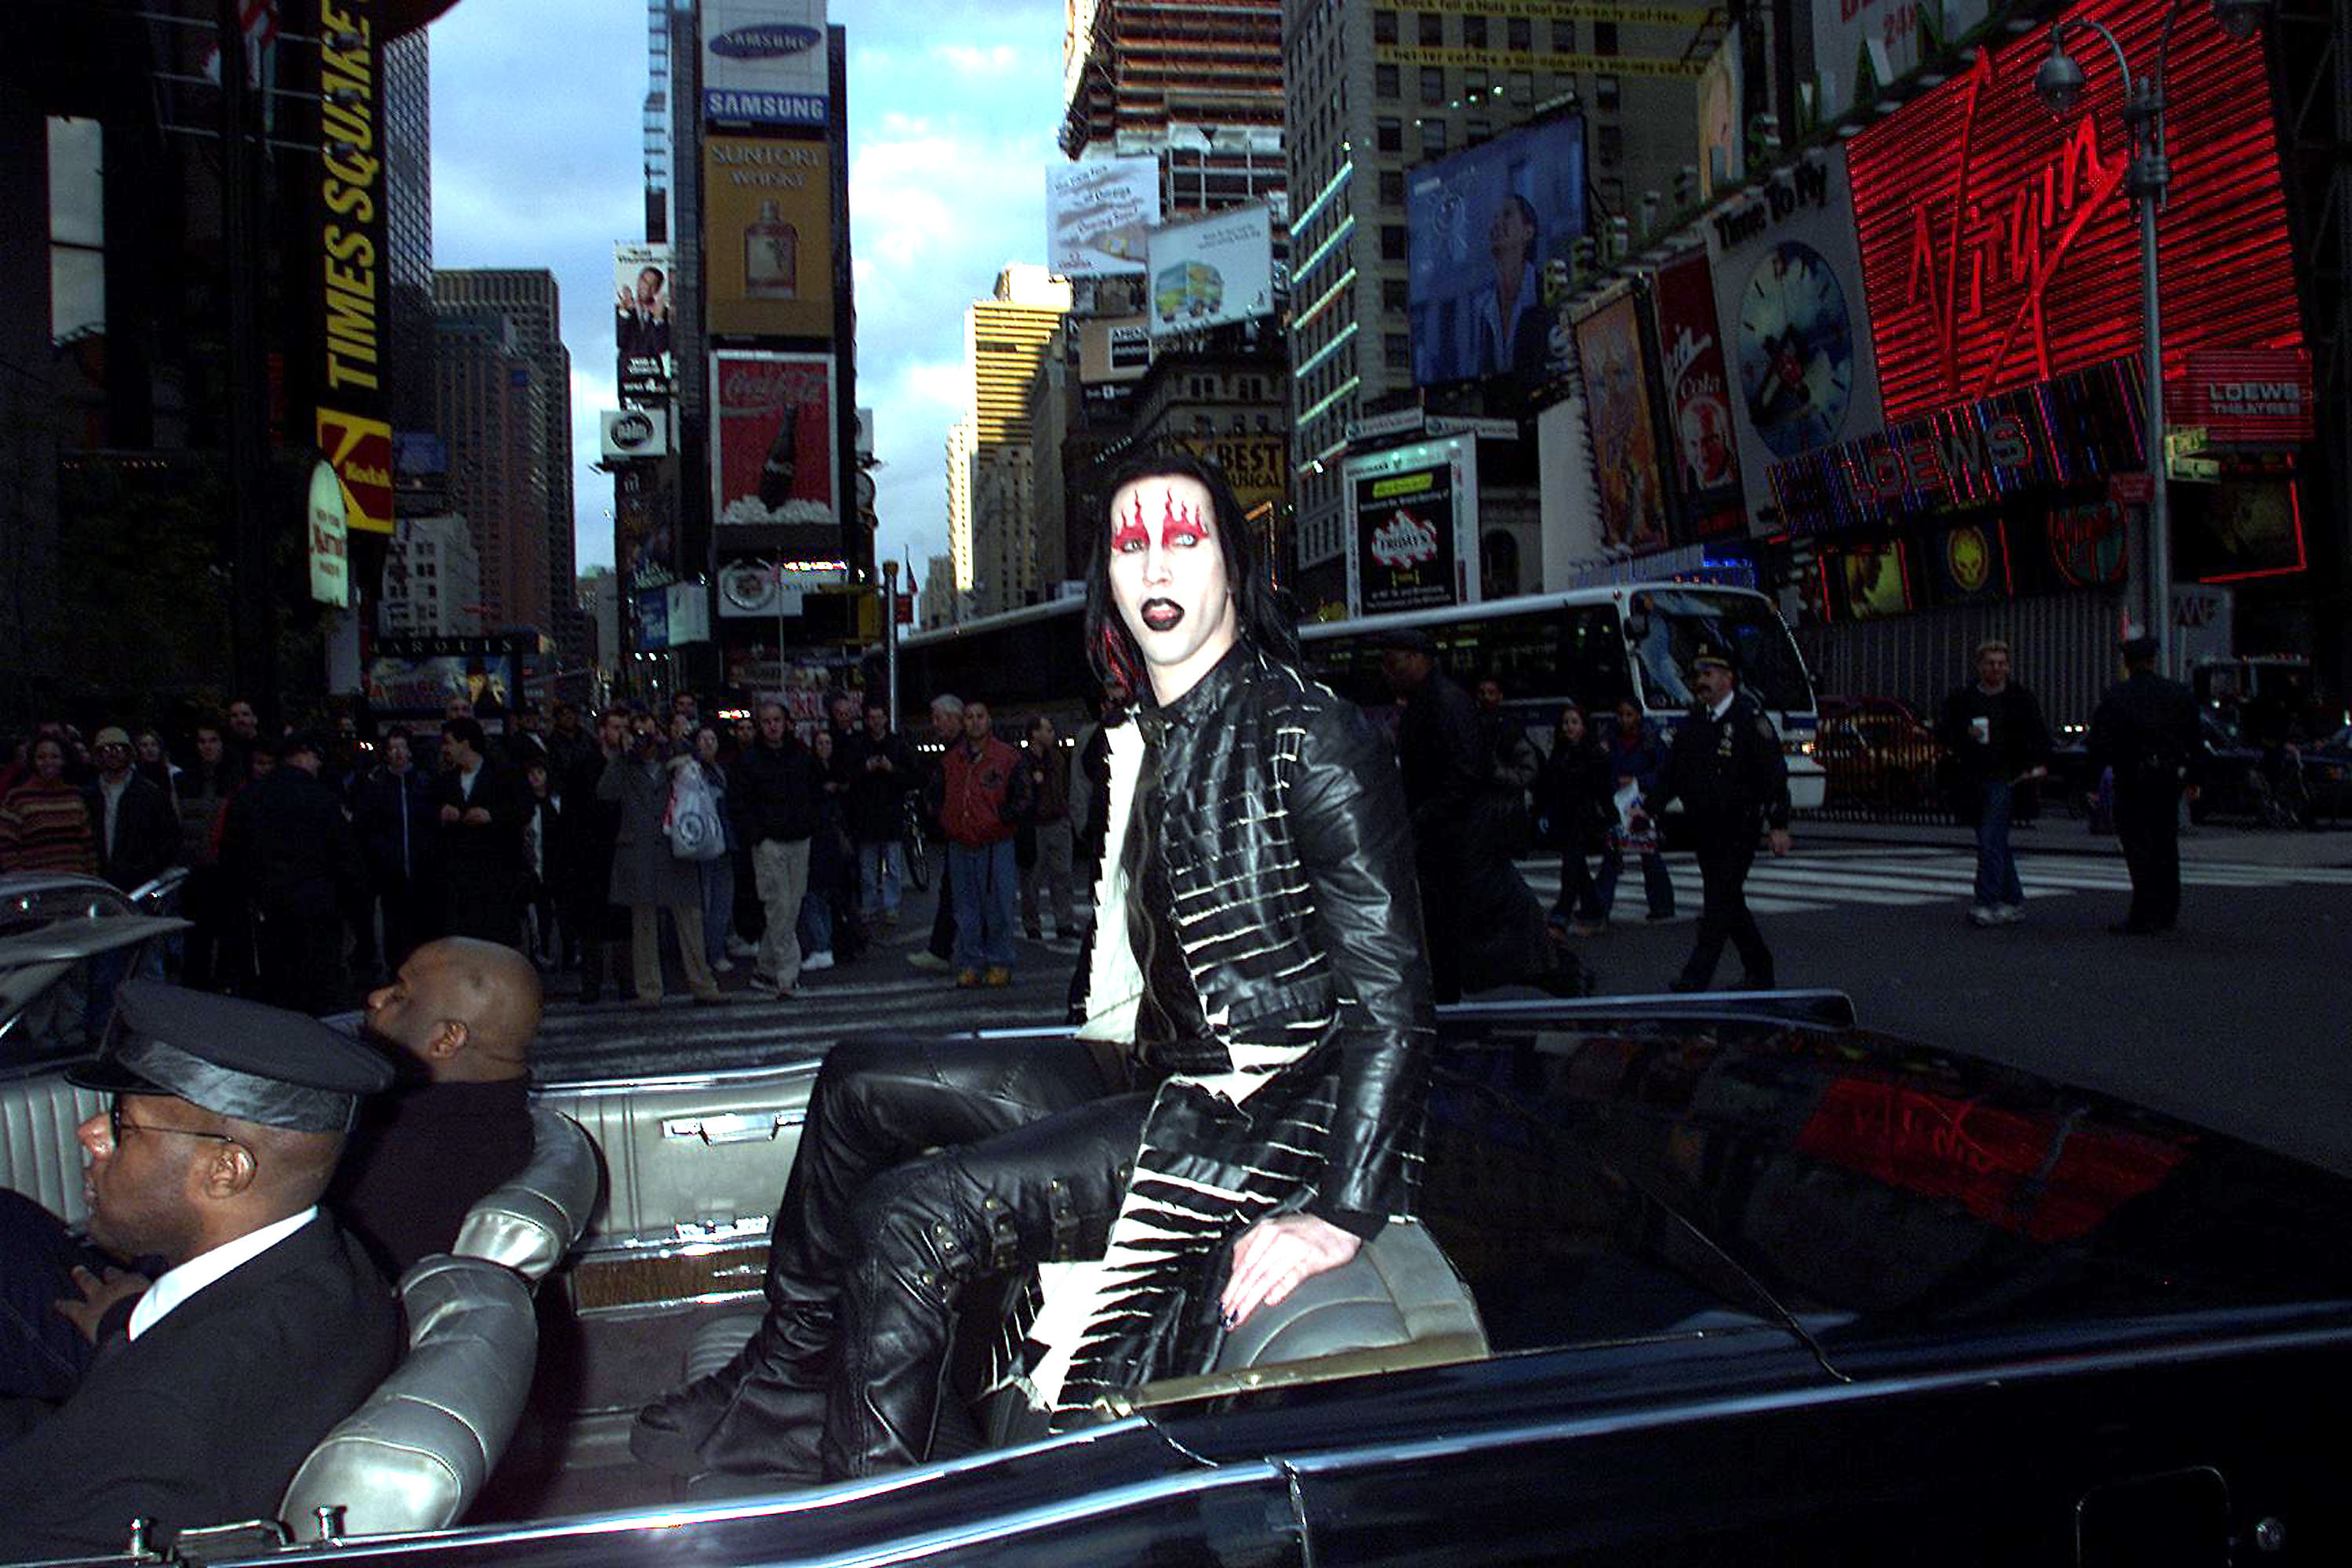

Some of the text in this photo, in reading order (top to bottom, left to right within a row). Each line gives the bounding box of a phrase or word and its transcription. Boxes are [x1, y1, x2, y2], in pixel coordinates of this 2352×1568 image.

[720, 32, 808, 49] SAMSUNG
[708, 91, 824, 120] SAMSUNG
[323, 223, 380, 390] TIMES
[2210, 382, 2299, 401] LOEWS
[1218, 444, 1281, 470] BEST
